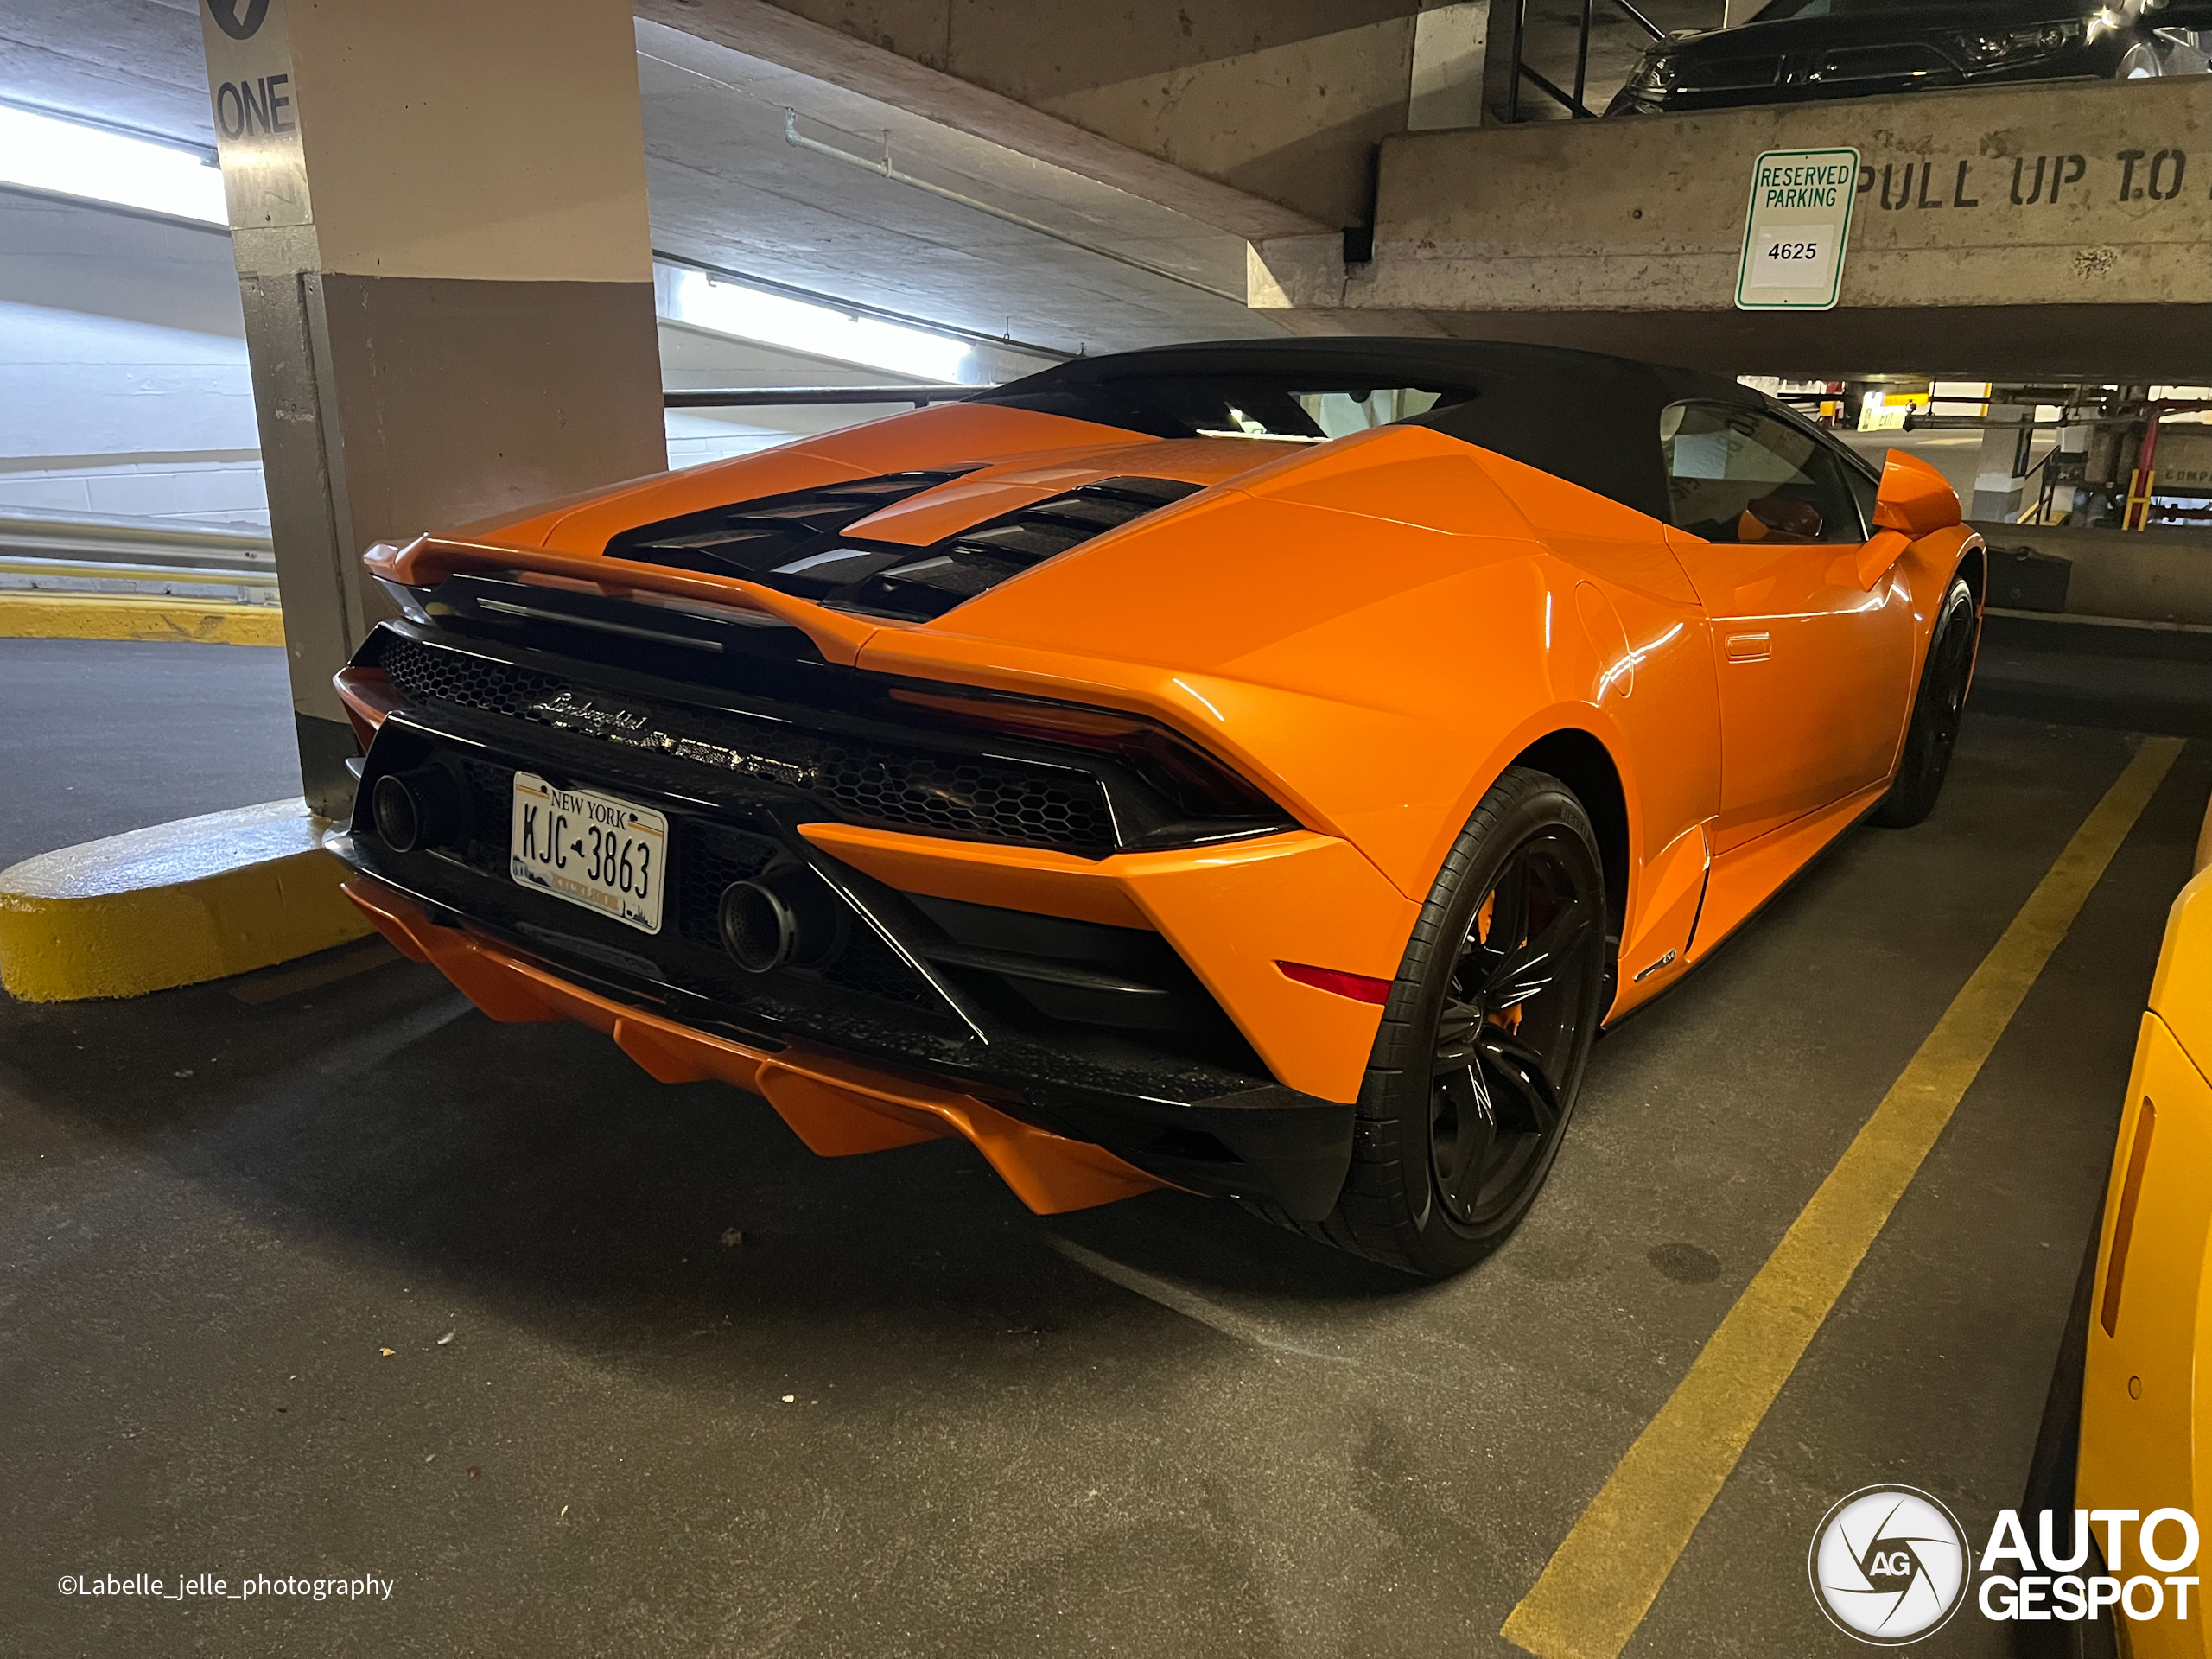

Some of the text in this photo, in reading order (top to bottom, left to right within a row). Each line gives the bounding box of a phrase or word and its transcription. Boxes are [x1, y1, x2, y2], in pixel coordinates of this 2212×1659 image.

[217, 73, 296, 141] ONE
[1760, 166, 1849, 188] RESERVED
[1857, 160, 1979, 211] PULL
[2010, 154, 2086, 206] UP
[2117, 149, 2187, 201] TO
[1766, 188, 1837, 208] PARKING
[1768, 243, 1817, 260] 4625
[550, 790, 628, 830] NEW YORK
[523, 803, 650, 899] KJC 3863
